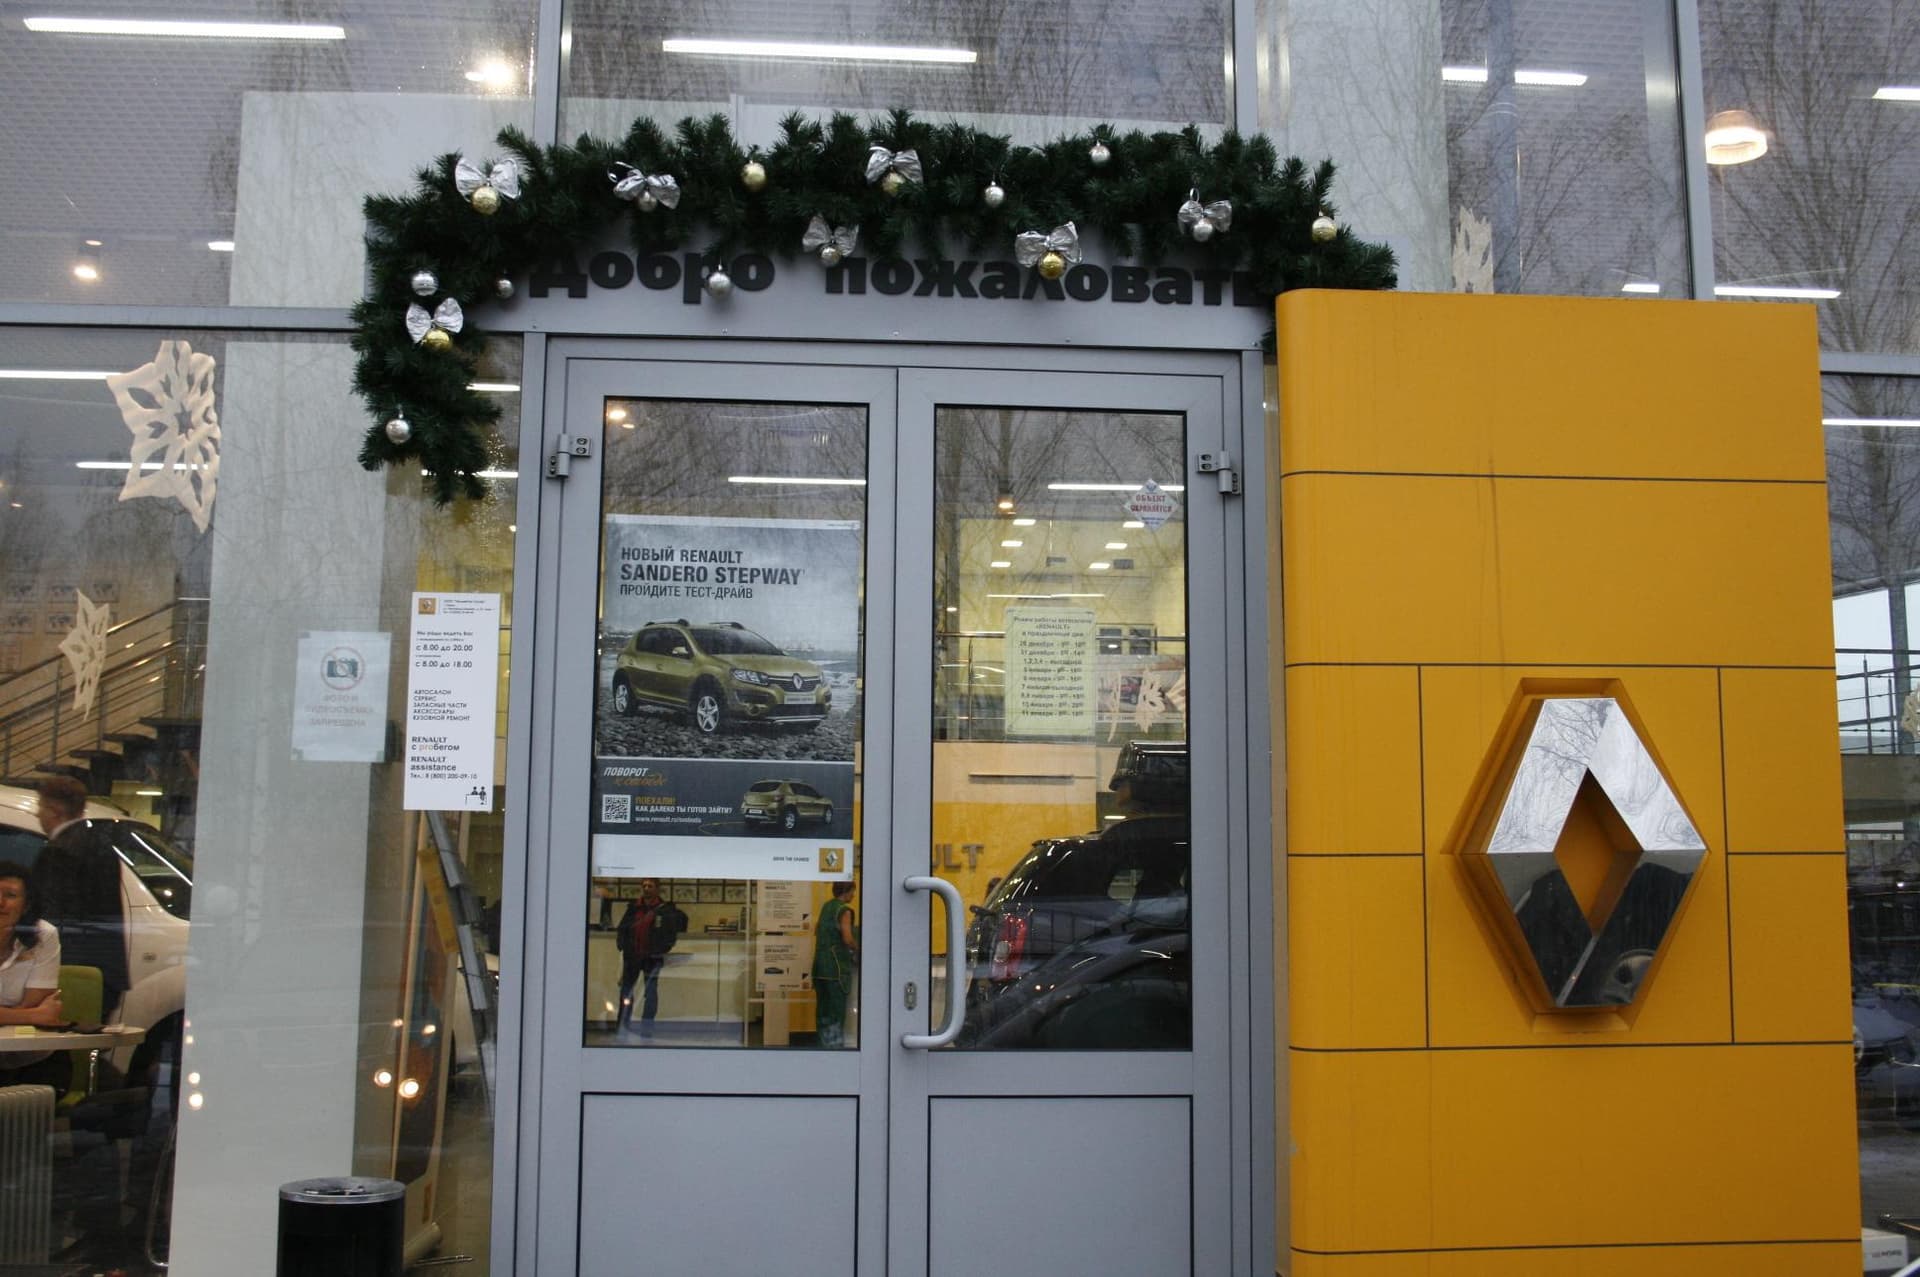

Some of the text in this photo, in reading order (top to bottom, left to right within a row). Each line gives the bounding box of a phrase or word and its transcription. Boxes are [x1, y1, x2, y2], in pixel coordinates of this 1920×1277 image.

[621, 546, 743, 564] НОВЫЙ RENAULT
[620, 563, 802, 585] SANDERO STEPWAY
[619, 583, 753, 600] ПРОЙДИТЕ ТЕСТ-ДРАЙВ
[603, 766, 649, 777] ПОВОРОТ
